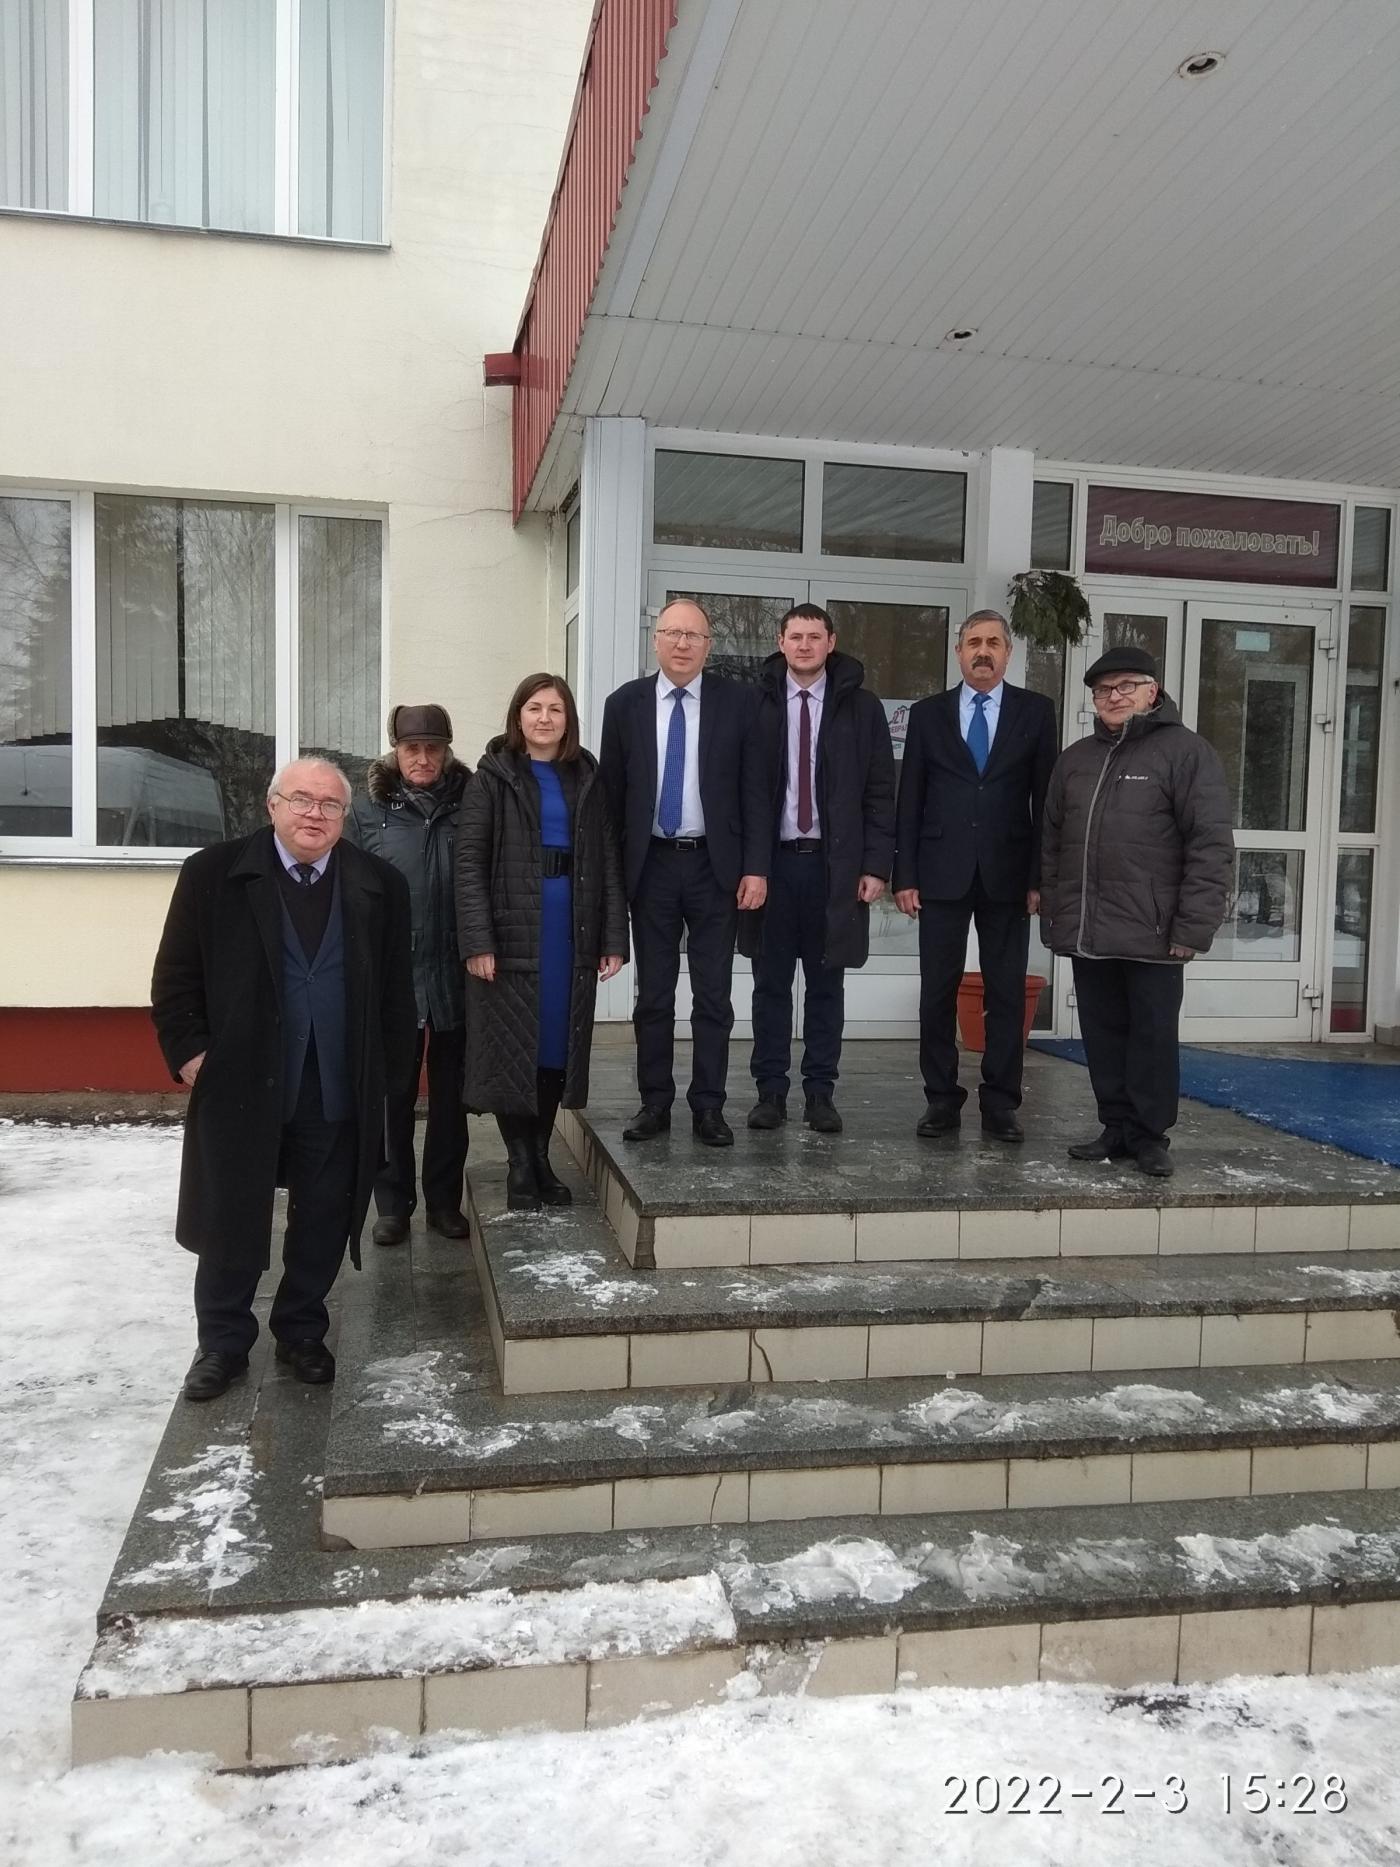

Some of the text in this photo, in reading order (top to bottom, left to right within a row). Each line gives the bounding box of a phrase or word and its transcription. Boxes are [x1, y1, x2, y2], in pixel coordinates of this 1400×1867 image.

[1100, 515, 1320, 556] Добро пожаловать!
[893, 710, 905, 724] 27
